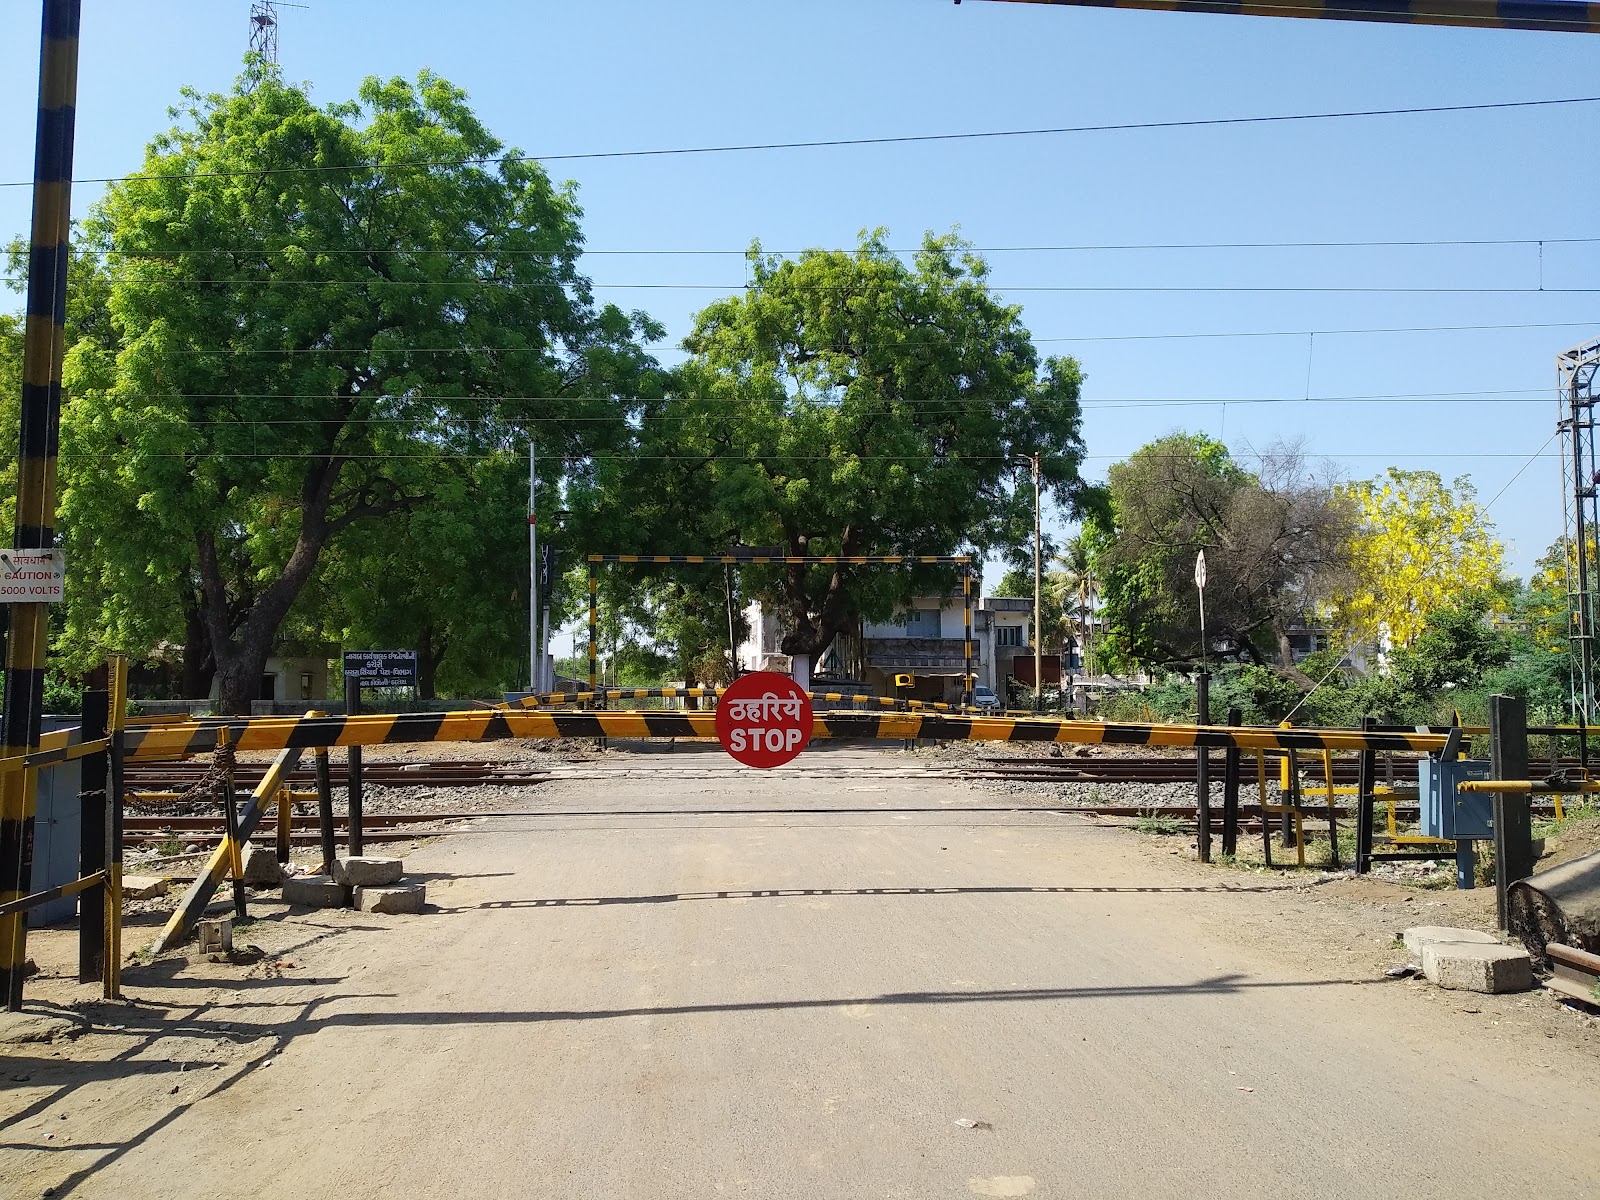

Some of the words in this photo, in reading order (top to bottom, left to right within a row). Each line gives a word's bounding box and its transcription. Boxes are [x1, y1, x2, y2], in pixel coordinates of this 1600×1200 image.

[4, 572, 52, 580] CAUTION
[29, 586, 60, 595] VOLTS
[366, 660, 382, 668] કચેરી
[727, 690, 804, 723] ठहरिये
[729, 728, 803, 752] STOP
